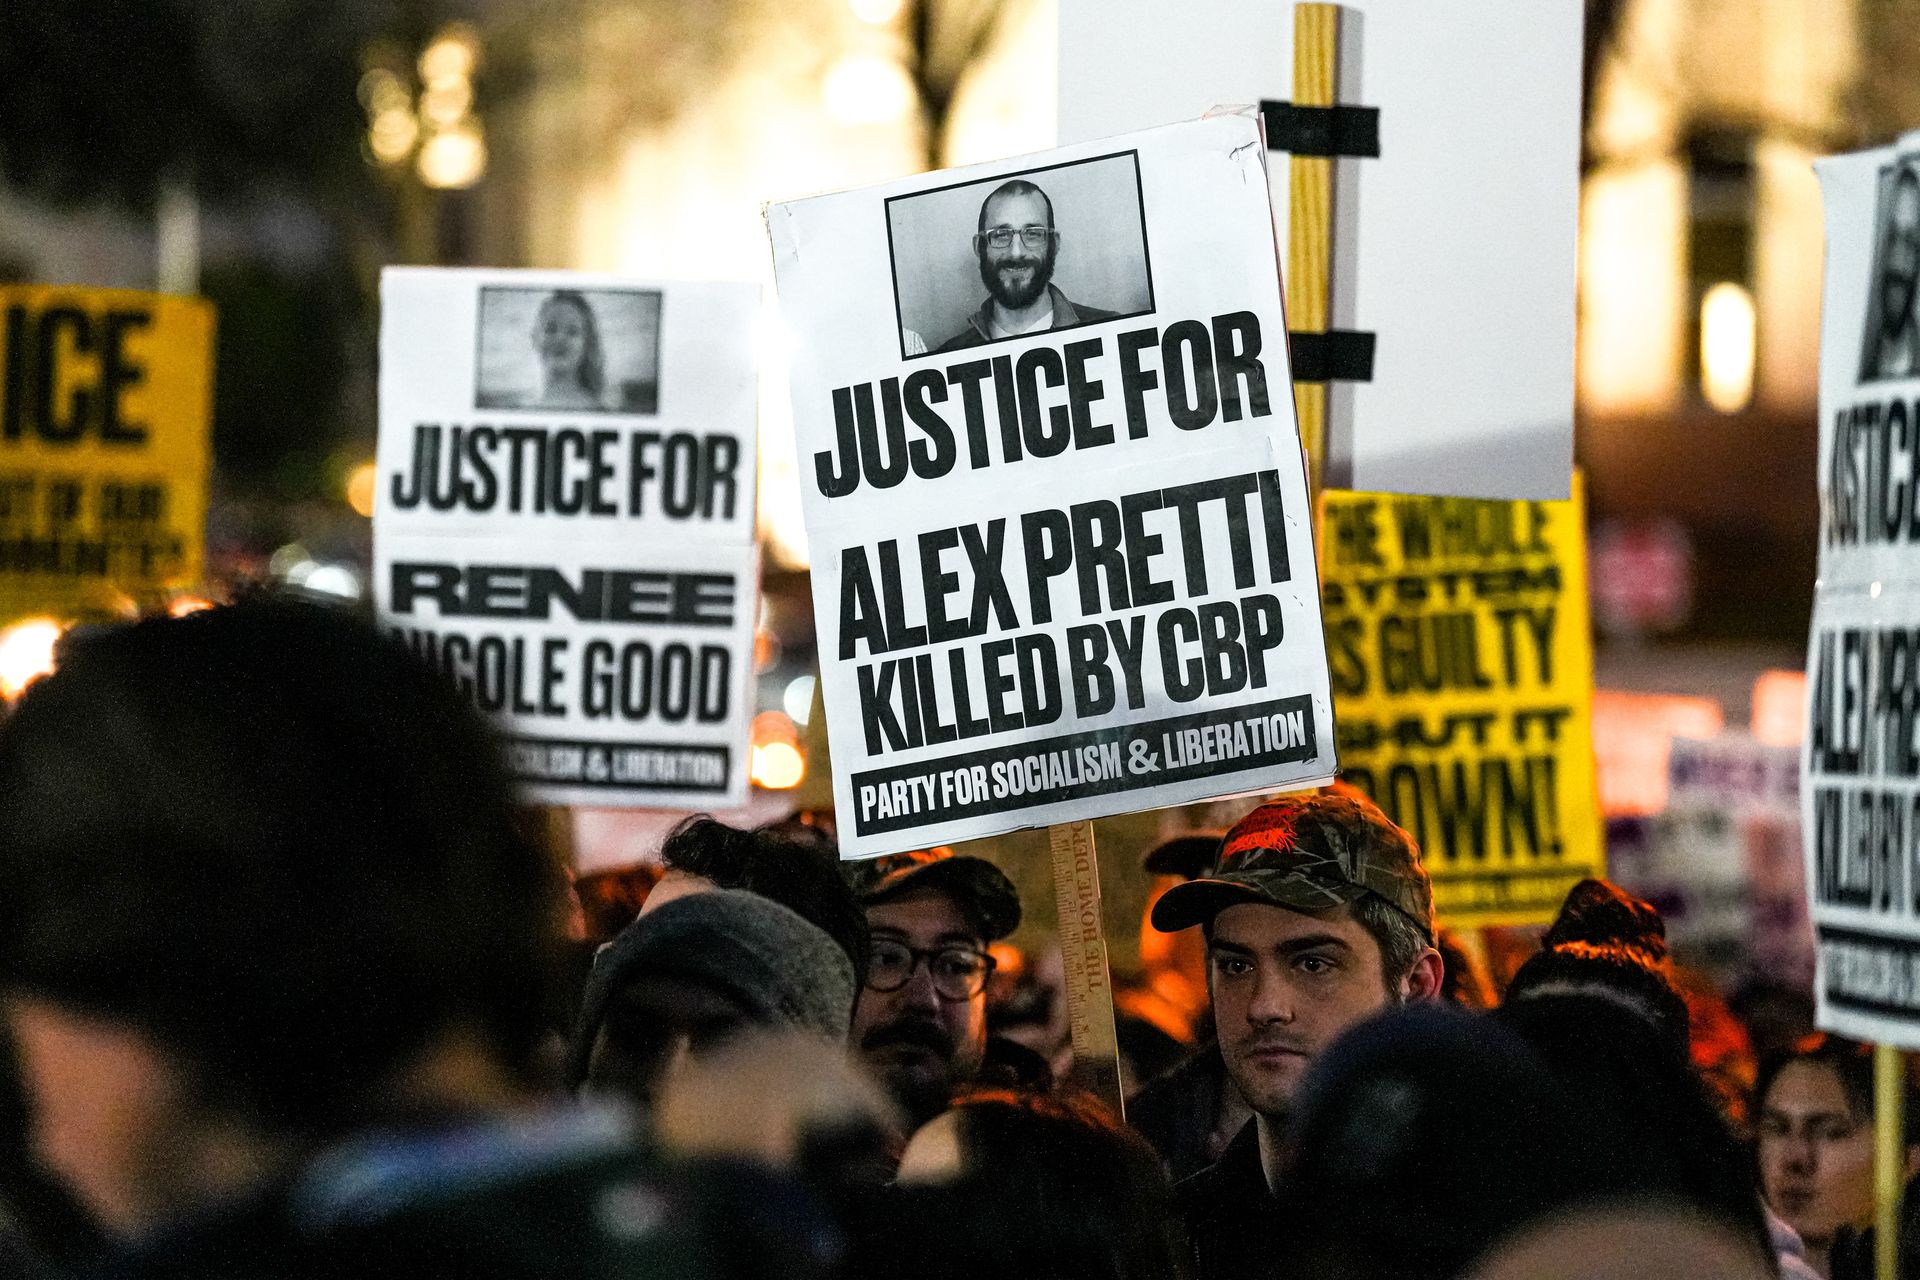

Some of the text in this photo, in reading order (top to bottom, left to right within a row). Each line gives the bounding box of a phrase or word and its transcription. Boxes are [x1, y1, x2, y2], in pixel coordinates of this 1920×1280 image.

[814, 310, 1272, 498] JUSTICE FOR
[391, 425, 740, 521] JUSTICE FOR
[391, 562, 736, 627] RENEE
[838, 469, 1291, 660] ALEX PRETTI
[581, 639, 731, 724] GOOD
[856, 594, 1285, 756] KILLED BY CBP
[1379, 606, 1557, 697] GUILTY
[860, 711, 1306, 823] PARTY FOR SOCIALISM & LIBERATION
[1512, 704, 1572, 745] IT
[1078, 878, 1098, 942] HOME
[1085, 948, 1103, 993] THE
